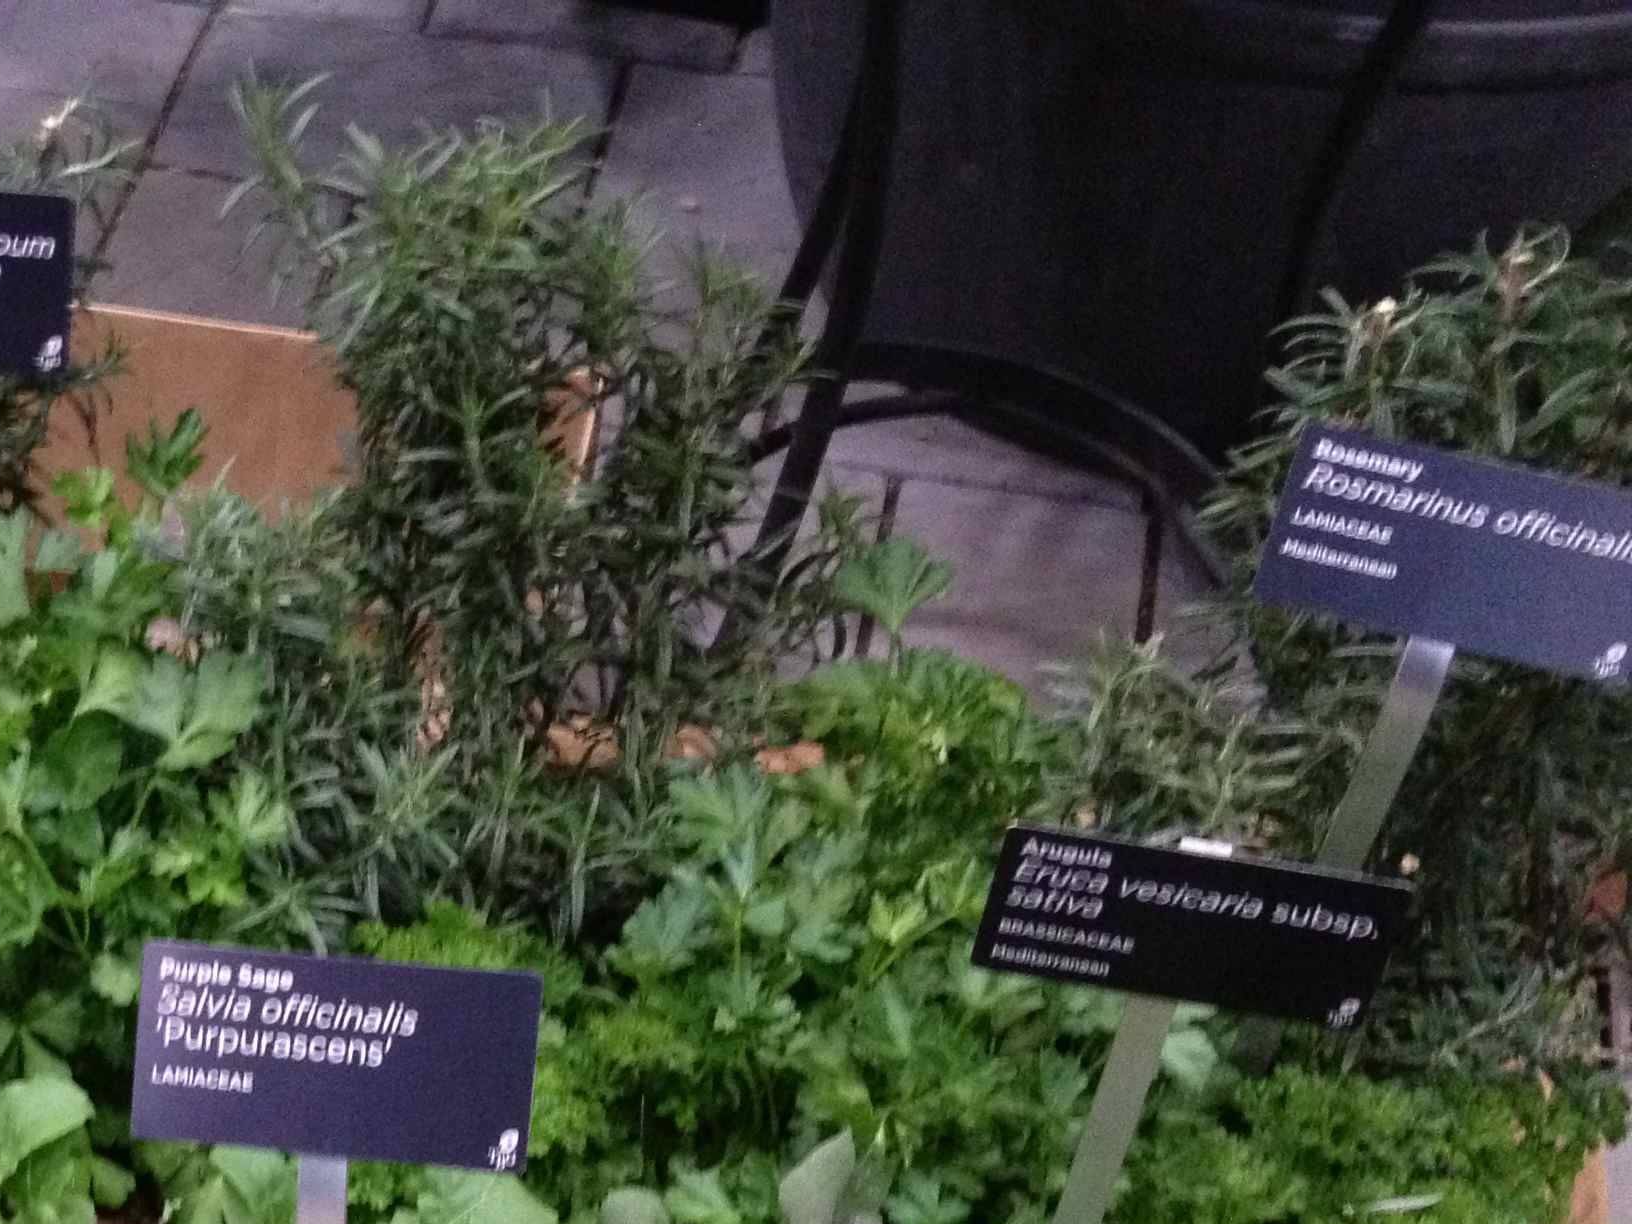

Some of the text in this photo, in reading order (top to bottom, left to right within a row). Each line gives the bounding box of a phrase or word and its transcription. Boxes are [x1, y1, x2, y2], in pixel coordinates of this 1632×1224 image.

[1313, 437, 1423, 483] Rosemary
[1301, 462, 1632, 564] Rosmarinus officinali
[1020, 836, 1113, 868] Arugula
[1004, 885, 1106, 920] sativa
[1013, 857, 1110, 895] Eruca
[1120, 876, 1265, 921] vesicaria
[159, 955, 294, 992] Purple Sage
[156, 982, 419, 1038] Salvia officinalis
[151, 1062, 255, 1094] LAMIACEAE
